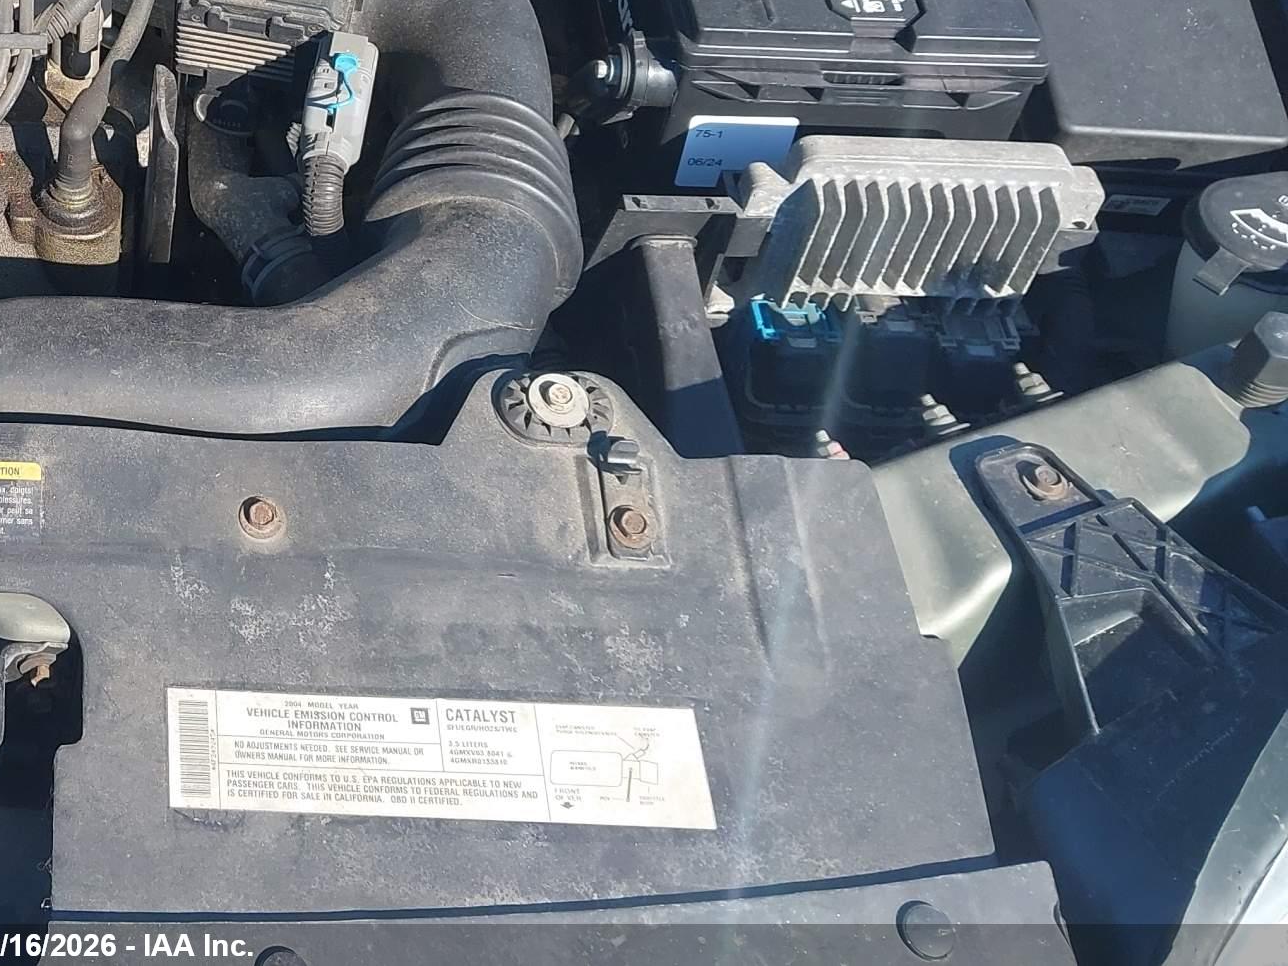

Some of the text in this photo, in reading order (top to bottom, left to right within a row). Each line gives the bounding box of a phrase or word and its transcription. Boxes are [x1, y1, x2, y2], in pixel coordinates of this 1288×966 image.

[695, 129, 723, 139] 75-1
[687, 157, 723, 167] 06/24
[307, 701, 333, 709] MODEL
[246, 707, 399, 722] VEHICLE EMISSION CONTROL
[446, 708, 516, 724] CATALYST
[287, 719, 362, 731] INFORMATION
[259, 728, 385, 740] GENERAL MOTORS CORPORATION
[234, 740, 244, 749] NO
[246, 741, 298, 751] ADJUSTMENTS
[334, 745, 348, 753] SEE
[350, 745, 379, 754] SERVICE
[382, 746, 412, 755] MANUAL
[413, 747, 424, 755] OR
[234, 750, 265, 760] OWNERS
[267, 752, 296, 761] MANUAL
[300, 754, 313, 762] FOR
[315, 754, 336, 763] MORE
[226, 770, 522, 789] THIS VEHICLE CONFORMS TO U.S. EPA REGULATIONS APPLICABLE TO NEW
[227, 779, 274, 789] PASSENGER
[306, 782, 326, 791] THIS
[327, 783, 361, 793] VEHICLE
[363, 784, 408, 794] CONFORMS
[411, 786, 421, 795] TO
[423, 787, 460, 796] FEDERAL
[462, 788, 519, 798] REGULATIONS
[521, 790, 538, 799] AND
[227, 788, 235, 797] IS
[238, 789, 279, 799] CERTIFIED
[282, 791, 298, 799] FOR
[301, 792, 320, 800] SALE
[323, 792, 332, 801] IN
[334, 792, 385, 802] CALIFORNIA.
[391, 795, 407, 804] OBD
[409, 796, 416, 804] II
